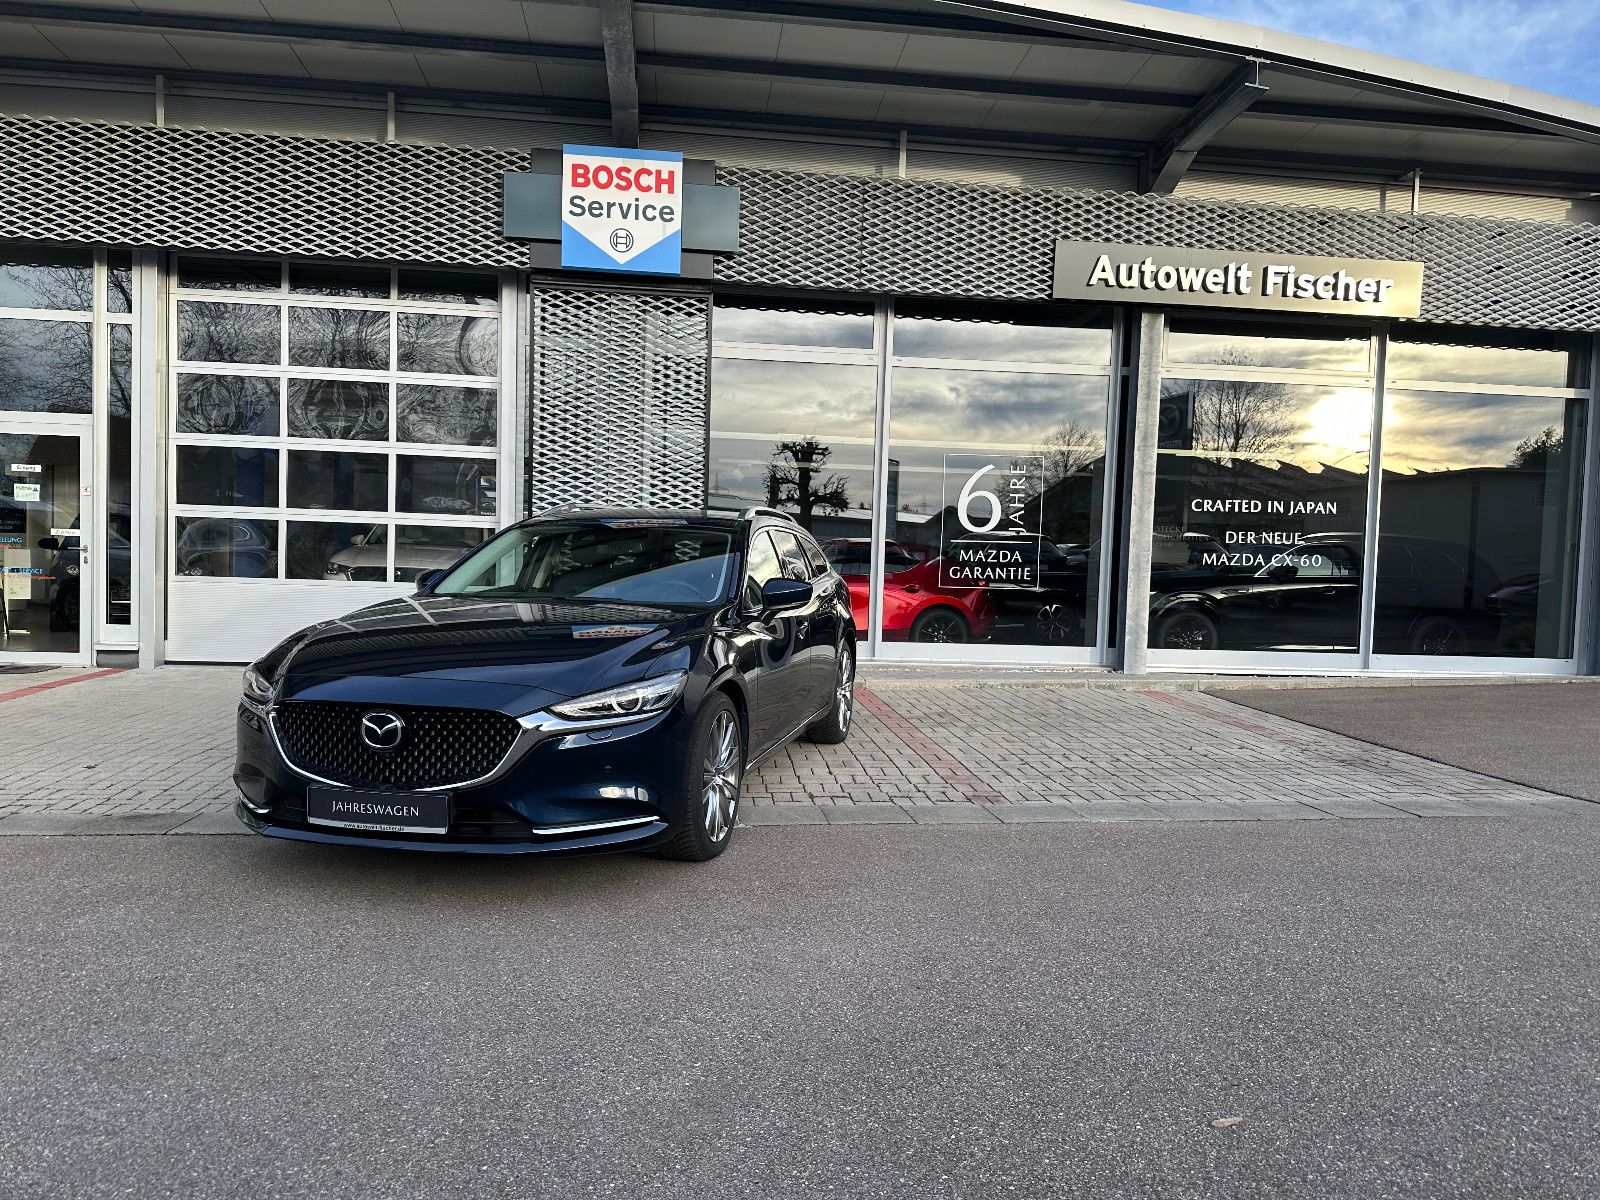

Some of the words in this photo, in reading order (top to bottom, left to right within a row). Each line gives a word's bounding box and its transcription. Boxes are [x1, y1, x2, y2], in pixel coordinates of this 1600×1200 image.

[571, 163, 675, 194] BOSCH
[569, 195, 675, 223] Service
[1087, 255, 1253, 295] Autowelt
[1262, 265, 1395, 303] Fischer
[957, 463, 1002, 534] 6
[1008, 464, 1027, 534] JAHRE
[1191, 498, 1262, 513] CRAFTED
[1267, 500, 1284, 513] IN
[1288, 501, 1337, 516] JAPAN
[1225, 530, 1257, 544] DER
[1261, 531, 1305, 545] NEUE
[959, 549, 1022, 563] MAZDA
[1202, 552, 1265, 567] MAZDA
[1271, 553, 1322, 567] CX-60
[949, 566, 1031, 580] GARANTIE
[331, 800, 419, 817] JAHRESWAGEN
